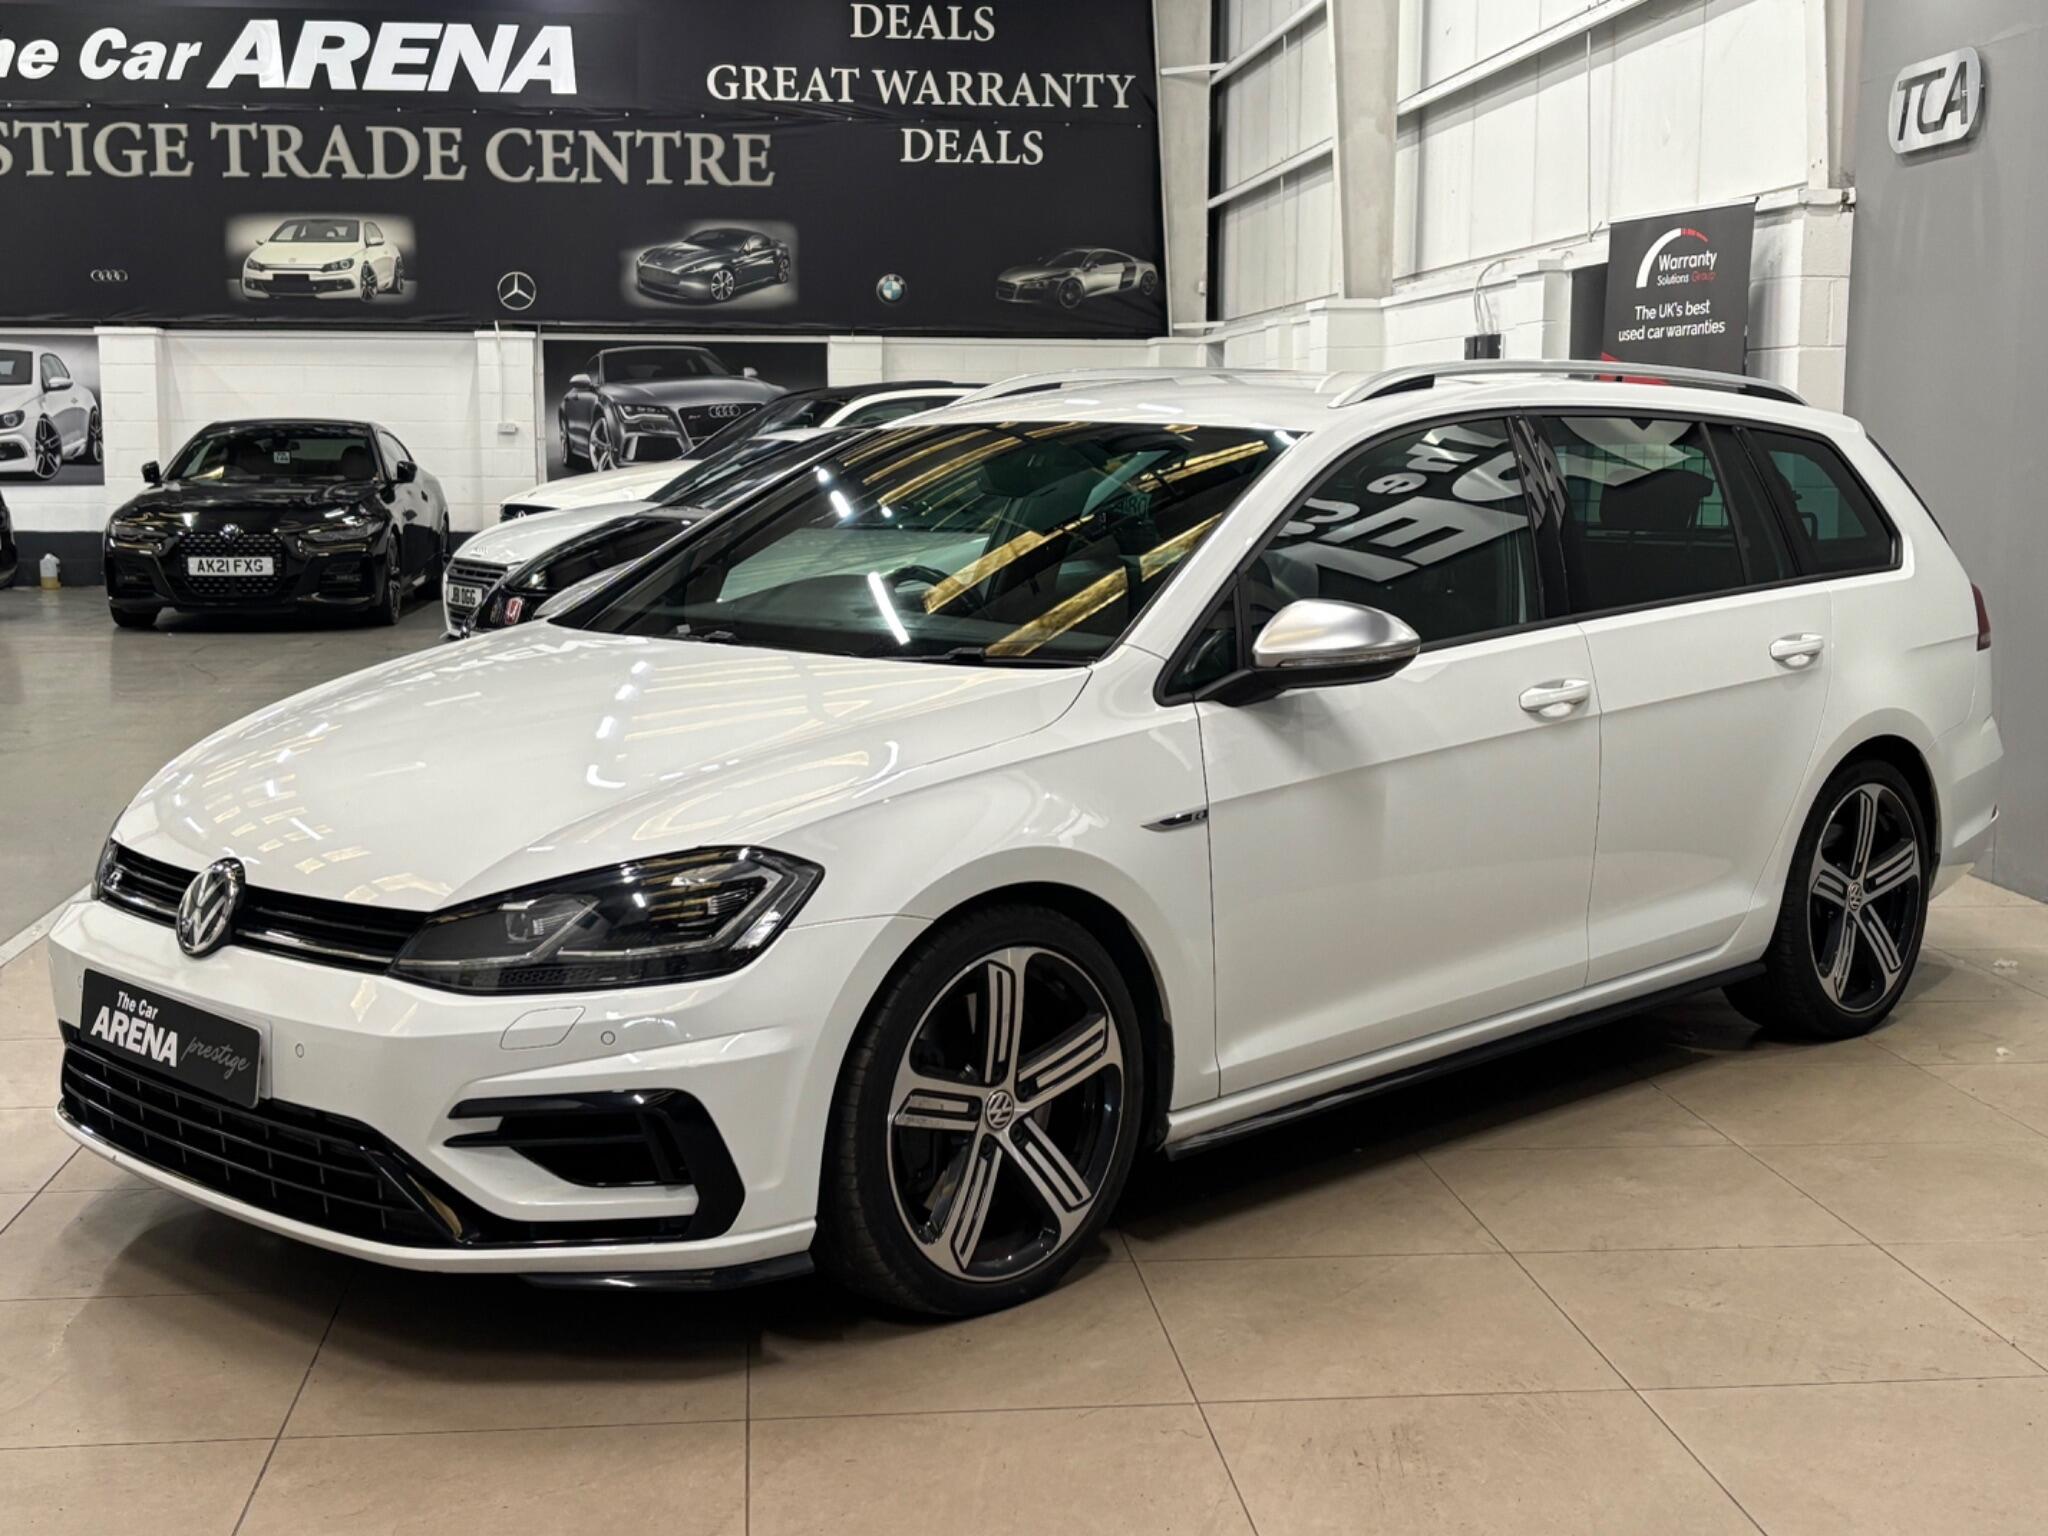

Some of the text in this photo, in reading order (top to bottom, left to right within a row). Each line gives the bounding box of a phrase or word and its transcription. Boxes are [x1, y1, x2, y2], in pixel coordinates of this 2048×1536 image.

[849, 3, 996, 42] DEALS
[80, 27, 203, 81] Car
[206, 19, 578, 95] ARENA
[706, 64, 1137, 109] GREAT WARRANTY
[1897, 61, 1968, 142] TCA
[210, 121, 467, 181] TRADE
[485, 127, 775, 187] CENTRE
[901, 128, 1045, 166] DEALS
[1658, 249, 1718, 272] Warranty
[1656, 273, 1690, 287] Solutions
[1634, 298, 1712, 321] The UK's best
[1618, 318, 1726, 342] used car warranties
[197, 559, 265, 574] AK21 FXG
[116, 990, 159, 1021] The Car
[90, 1005, 251, 1081] ARENA prestige
